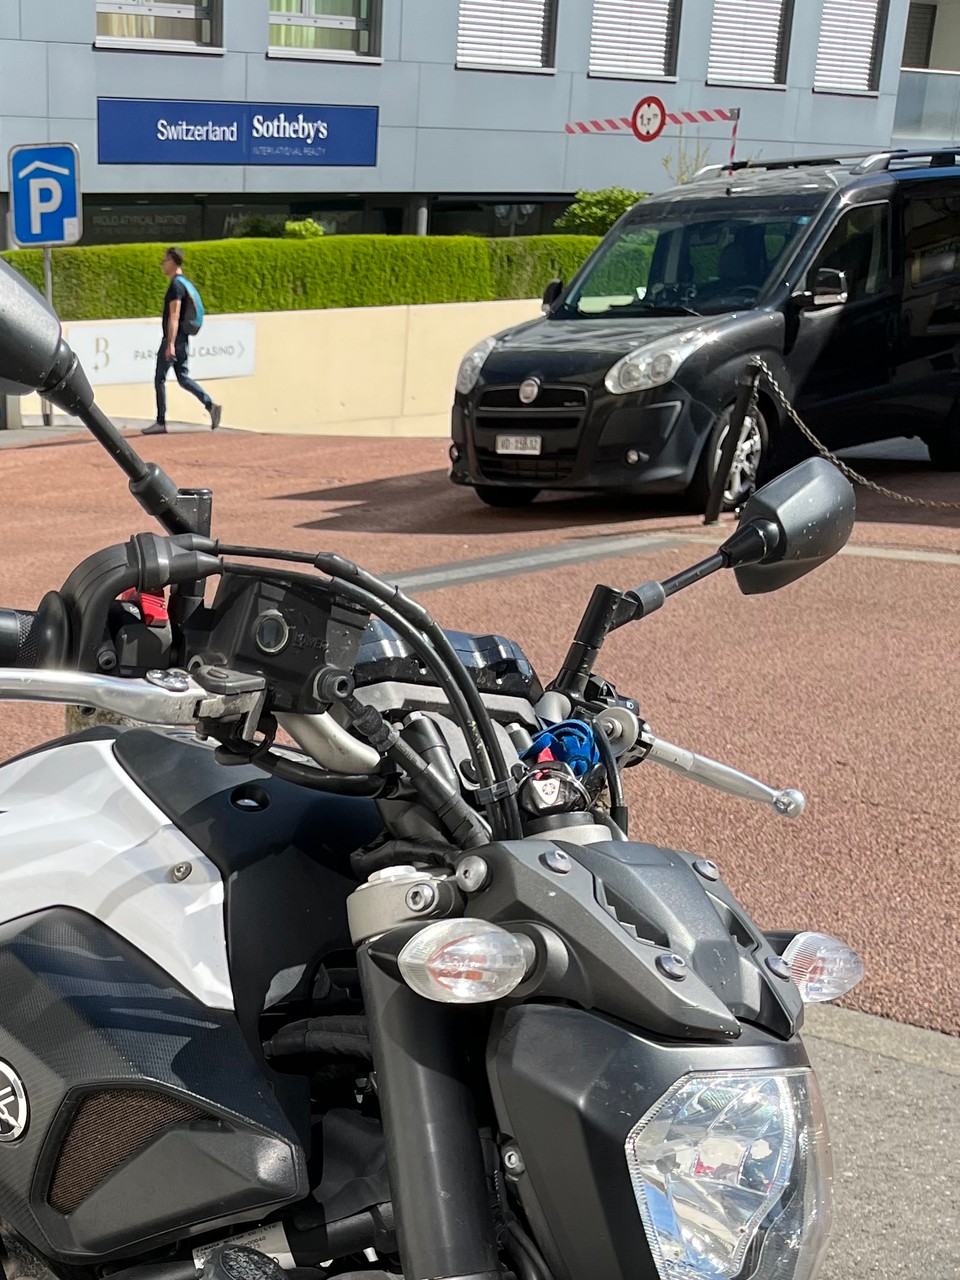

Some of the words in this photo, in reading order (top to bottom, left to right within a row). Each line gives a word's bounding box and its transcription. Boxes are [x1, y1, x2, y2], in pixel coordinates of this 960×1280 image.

[156, 119, 238, 142] Switzerland
[252, 113, 328, 144] Sotheby's
[29, 177, 63, 235] P
